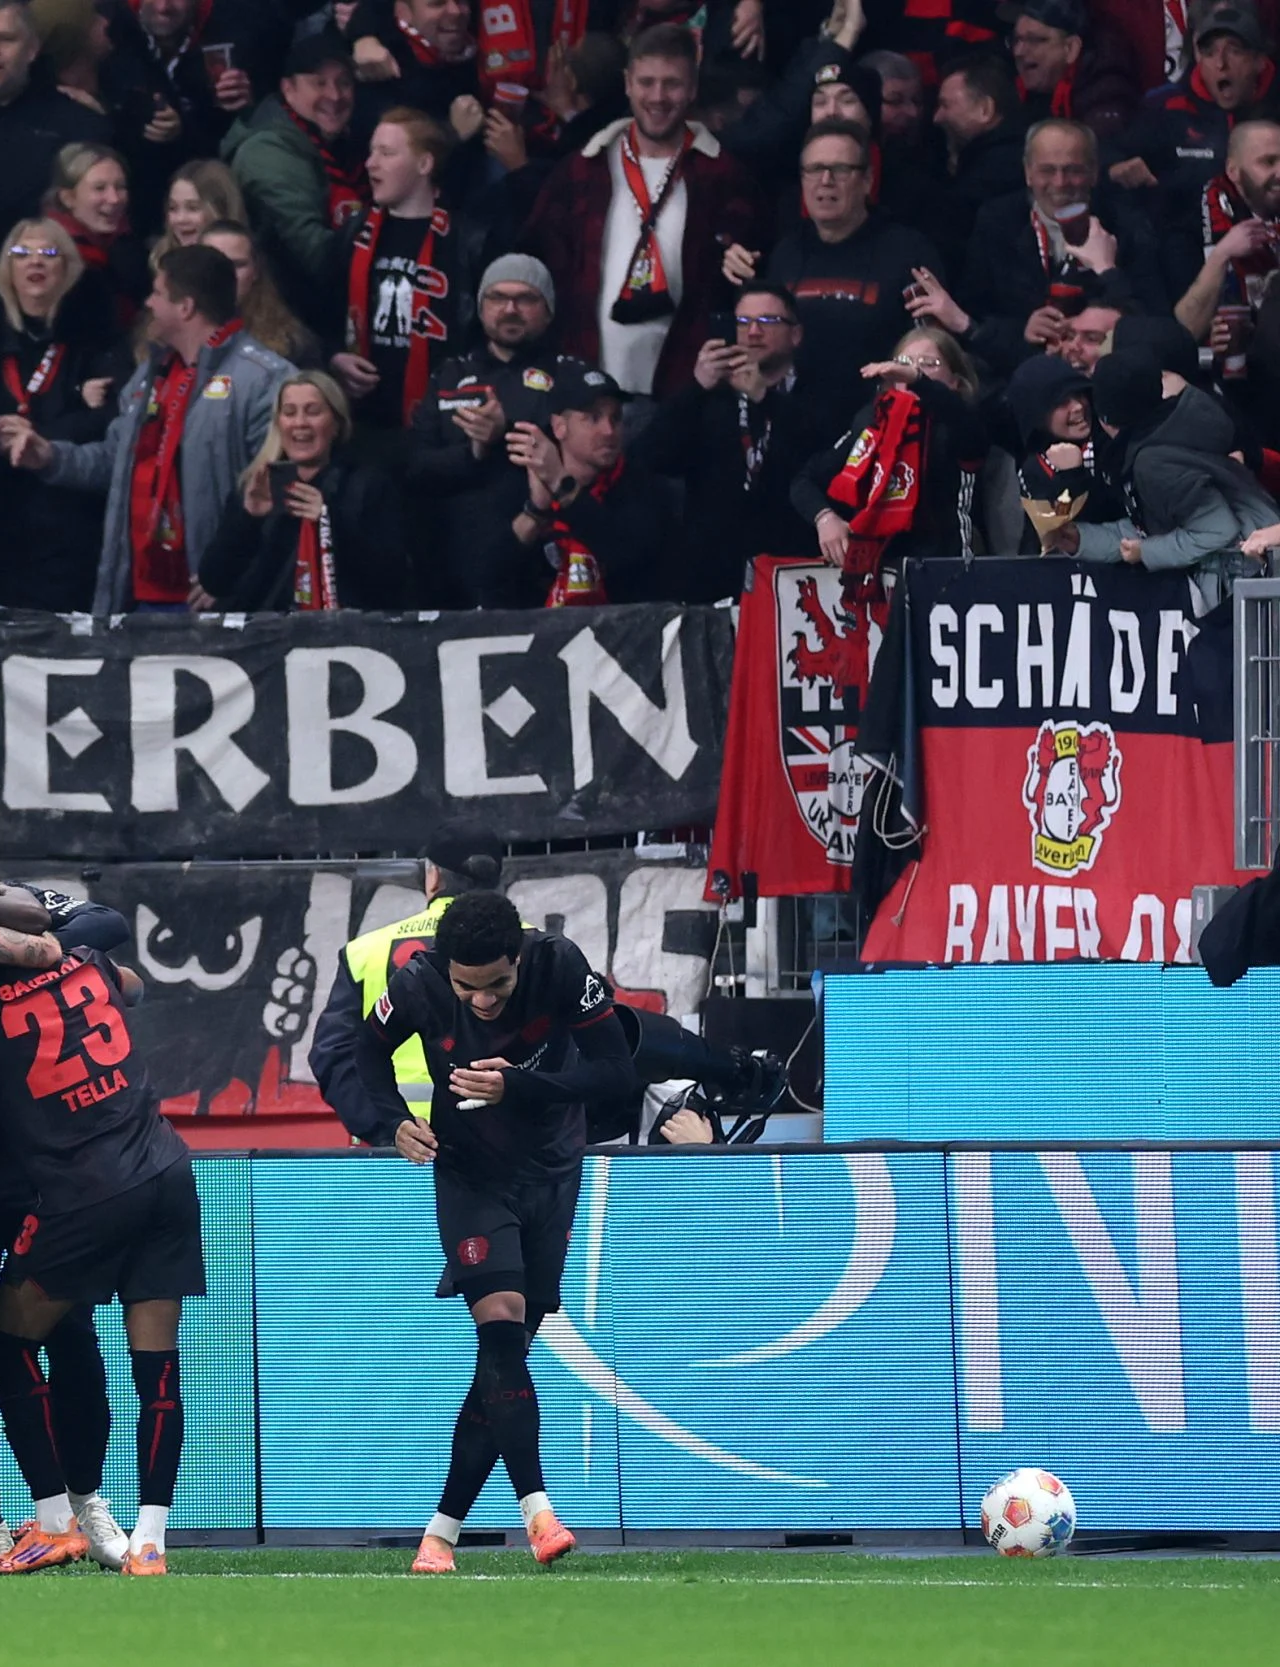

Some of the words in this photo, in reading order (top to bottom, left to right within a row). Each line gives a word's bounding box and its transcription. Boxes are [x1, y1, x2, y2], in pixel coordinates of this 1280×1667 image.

[1, 613, 700, 813] ERBEN
[1046, 791, 1080, 807] BAY
[0, 960, 132, 1101] 23
[60, 1067, 130, 1114] TELLA
